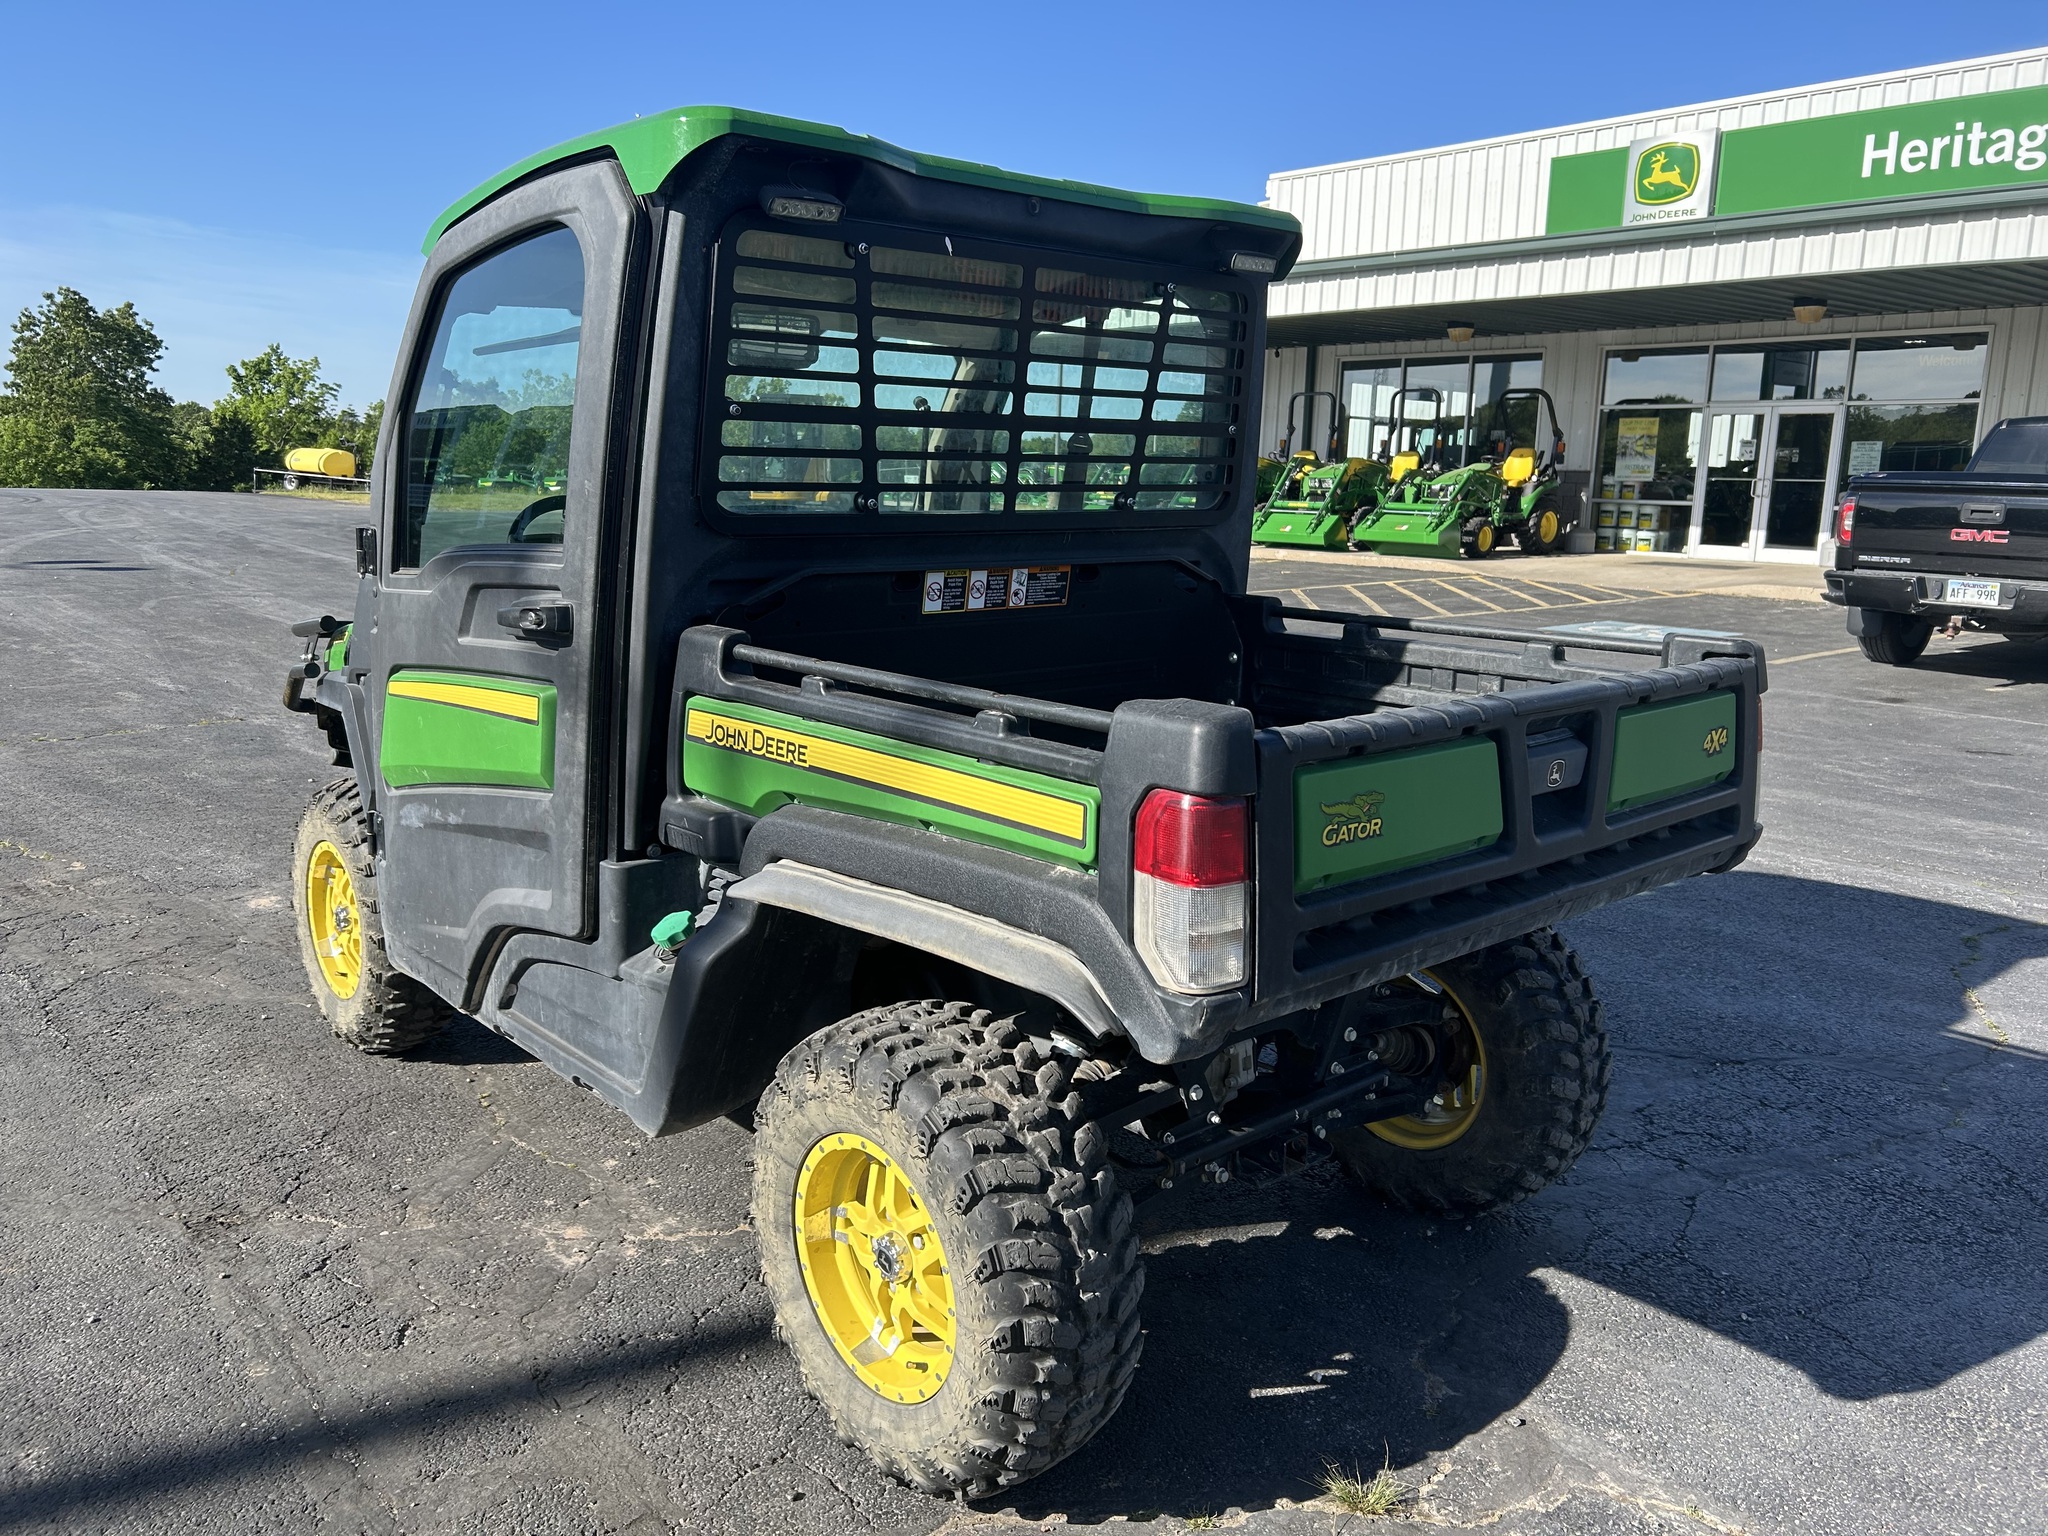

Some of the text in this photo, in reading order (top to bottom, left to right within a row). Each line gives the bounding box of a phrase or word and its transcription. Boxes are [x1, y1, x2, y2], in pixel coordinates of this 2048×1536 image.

[1861, 121, 2048, 179] Heritag
[1629, 208, 1697, 223] JOHN DEERE
[1950, 528, 2010, 544] GMC
[1950, 587, 1997, 601] AFF 99R
[705, 719, 808, 764] JOHN DEERE
[1322, 818, 1382, 847] GATOR
